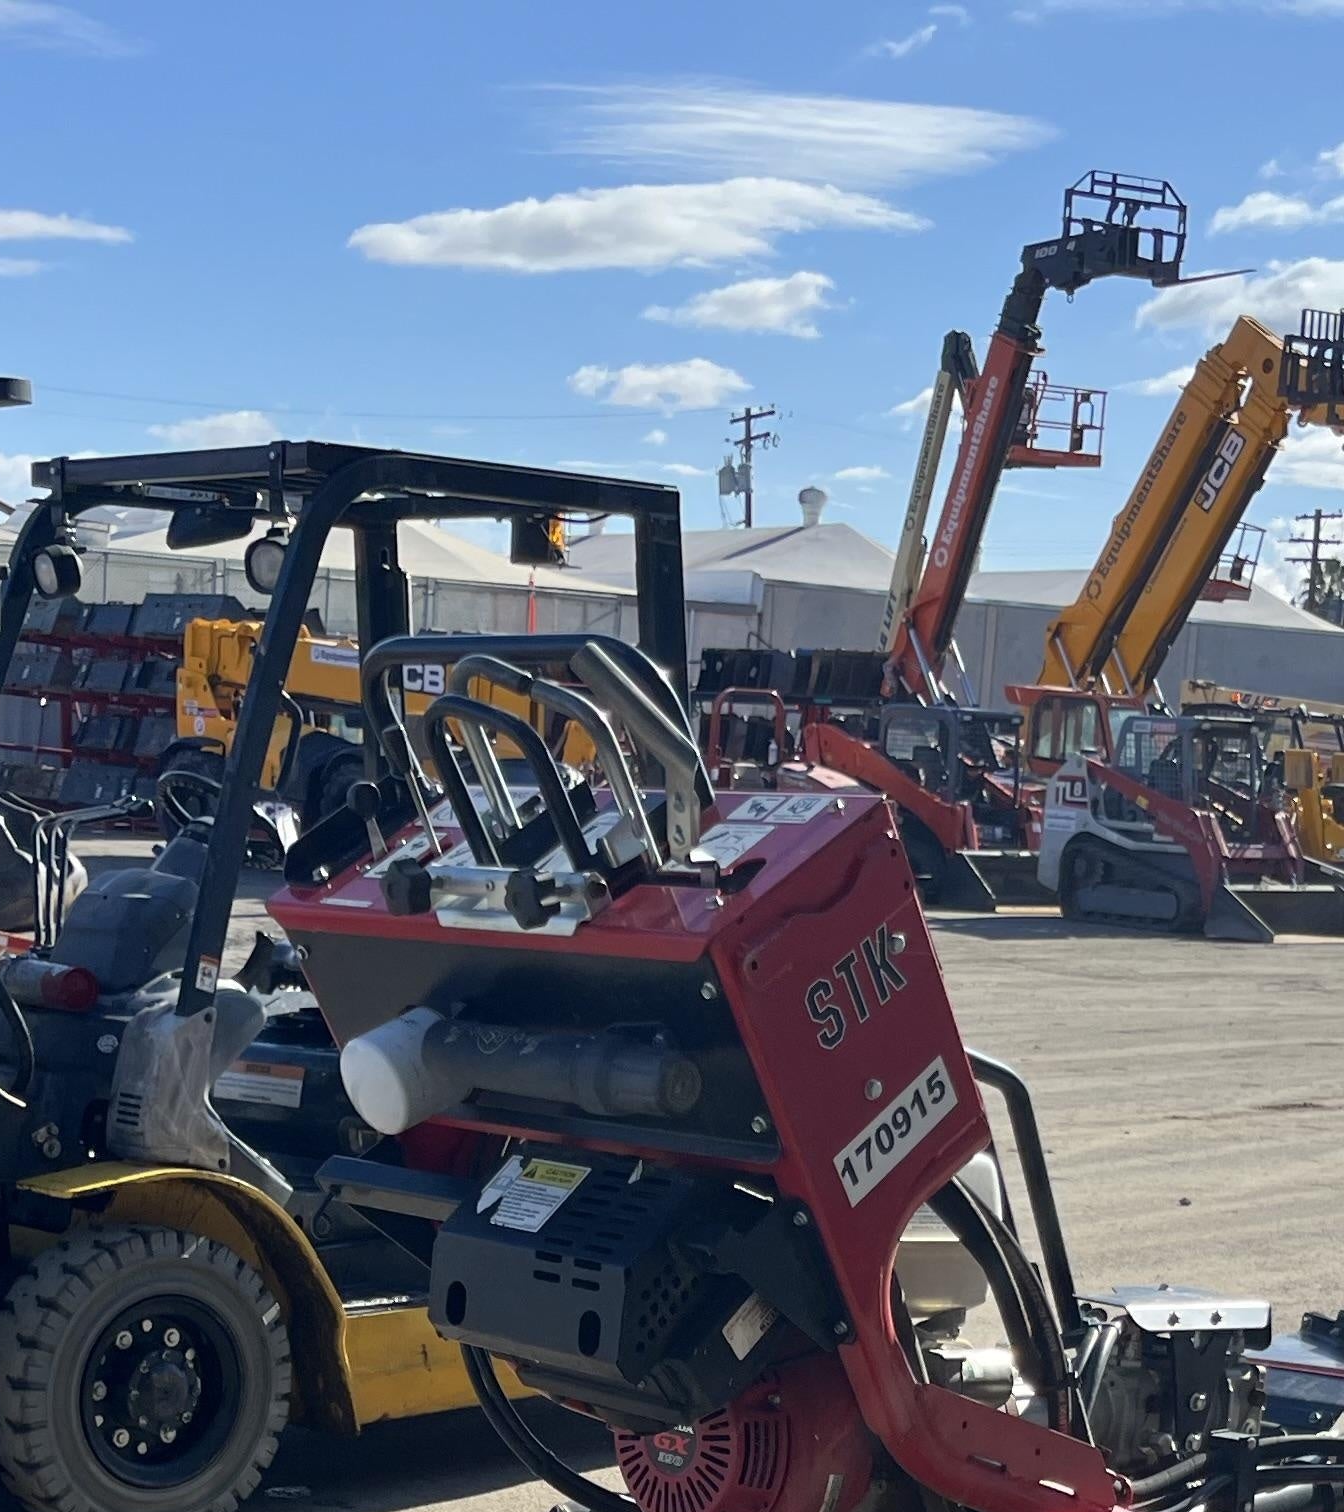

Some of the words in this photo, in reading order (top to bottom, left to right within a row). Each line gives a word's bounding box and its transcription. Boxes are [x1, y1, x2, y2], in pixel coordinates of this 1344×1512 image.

[940, 375, 1000, 546] EquipmentShare
[1099, 411, 1187, 579] EquipmentShare
[1195, 429, 1247, 513] JCB
[406, 664, 445, 695] CB
[804, 922, 907, 1050] STK
[839, 1069, 947, 1188] 170915
[653, 1433, 689, 1456] GX
